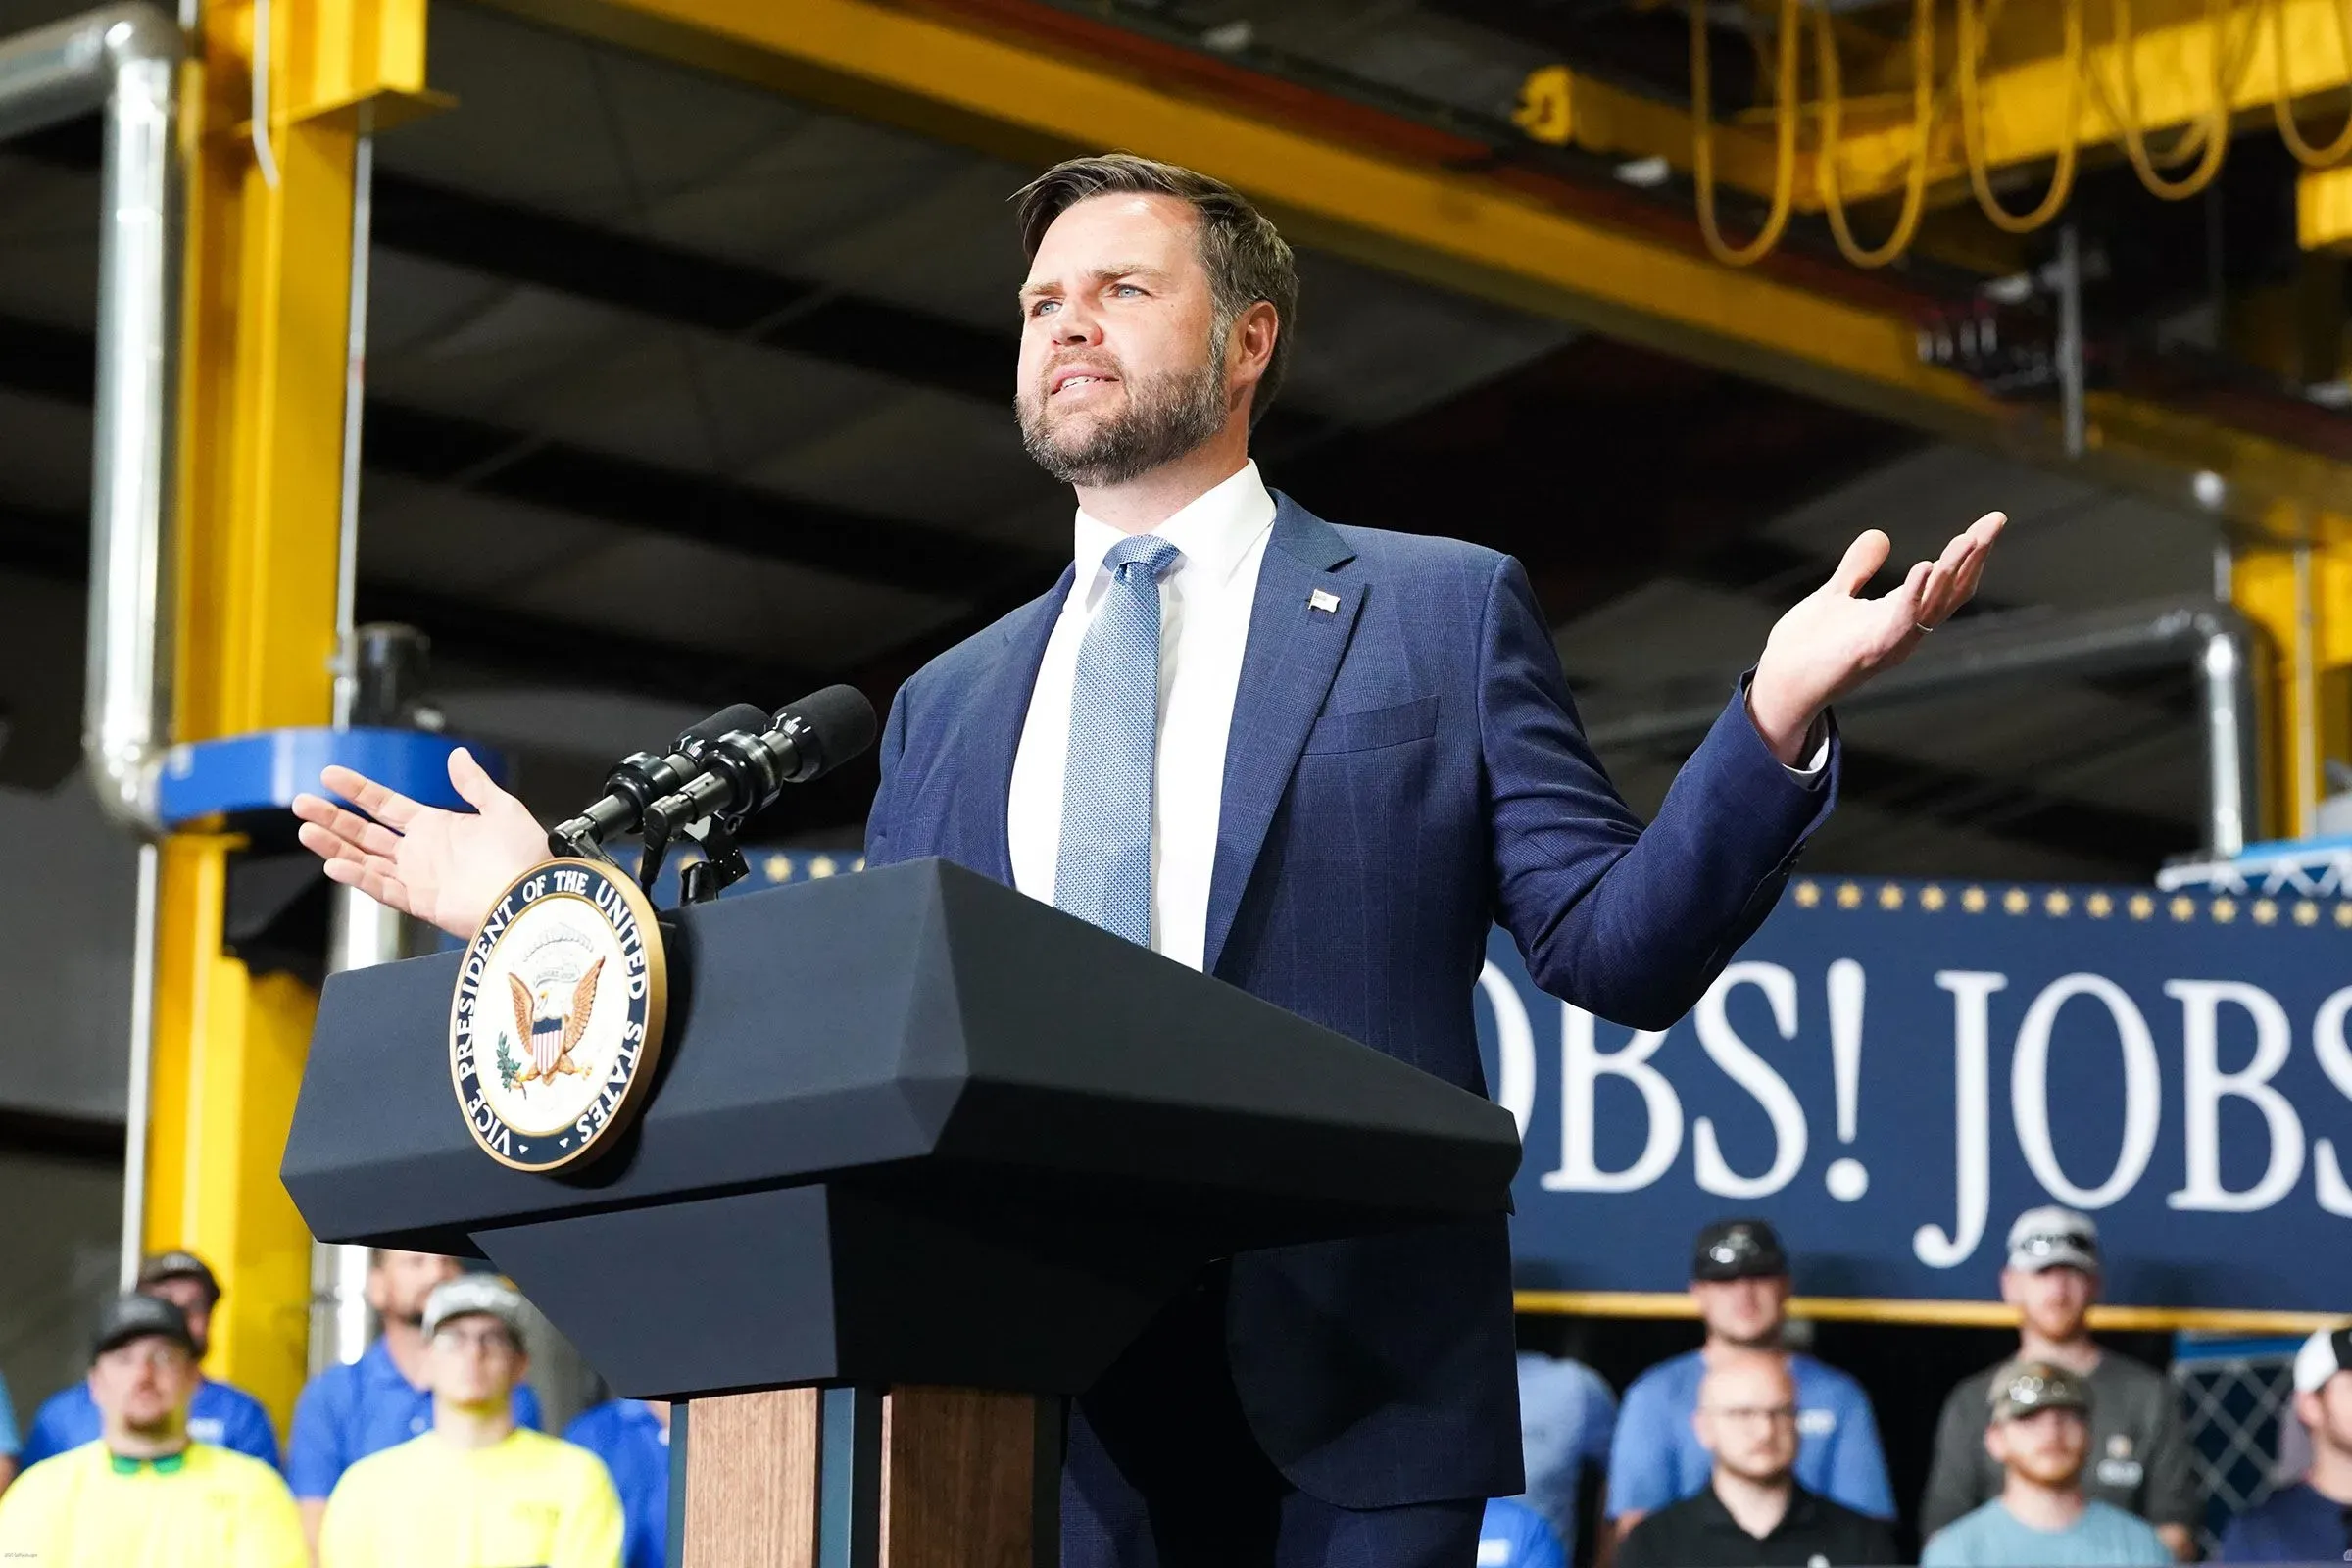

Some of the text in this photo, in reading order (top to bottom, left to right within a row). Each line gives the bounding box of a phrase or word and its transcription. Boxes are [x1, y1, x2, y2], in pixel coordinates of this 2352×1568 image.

[455, 870, 647, 1157] VICE PRESIDENT OF THE UNITED STATES
